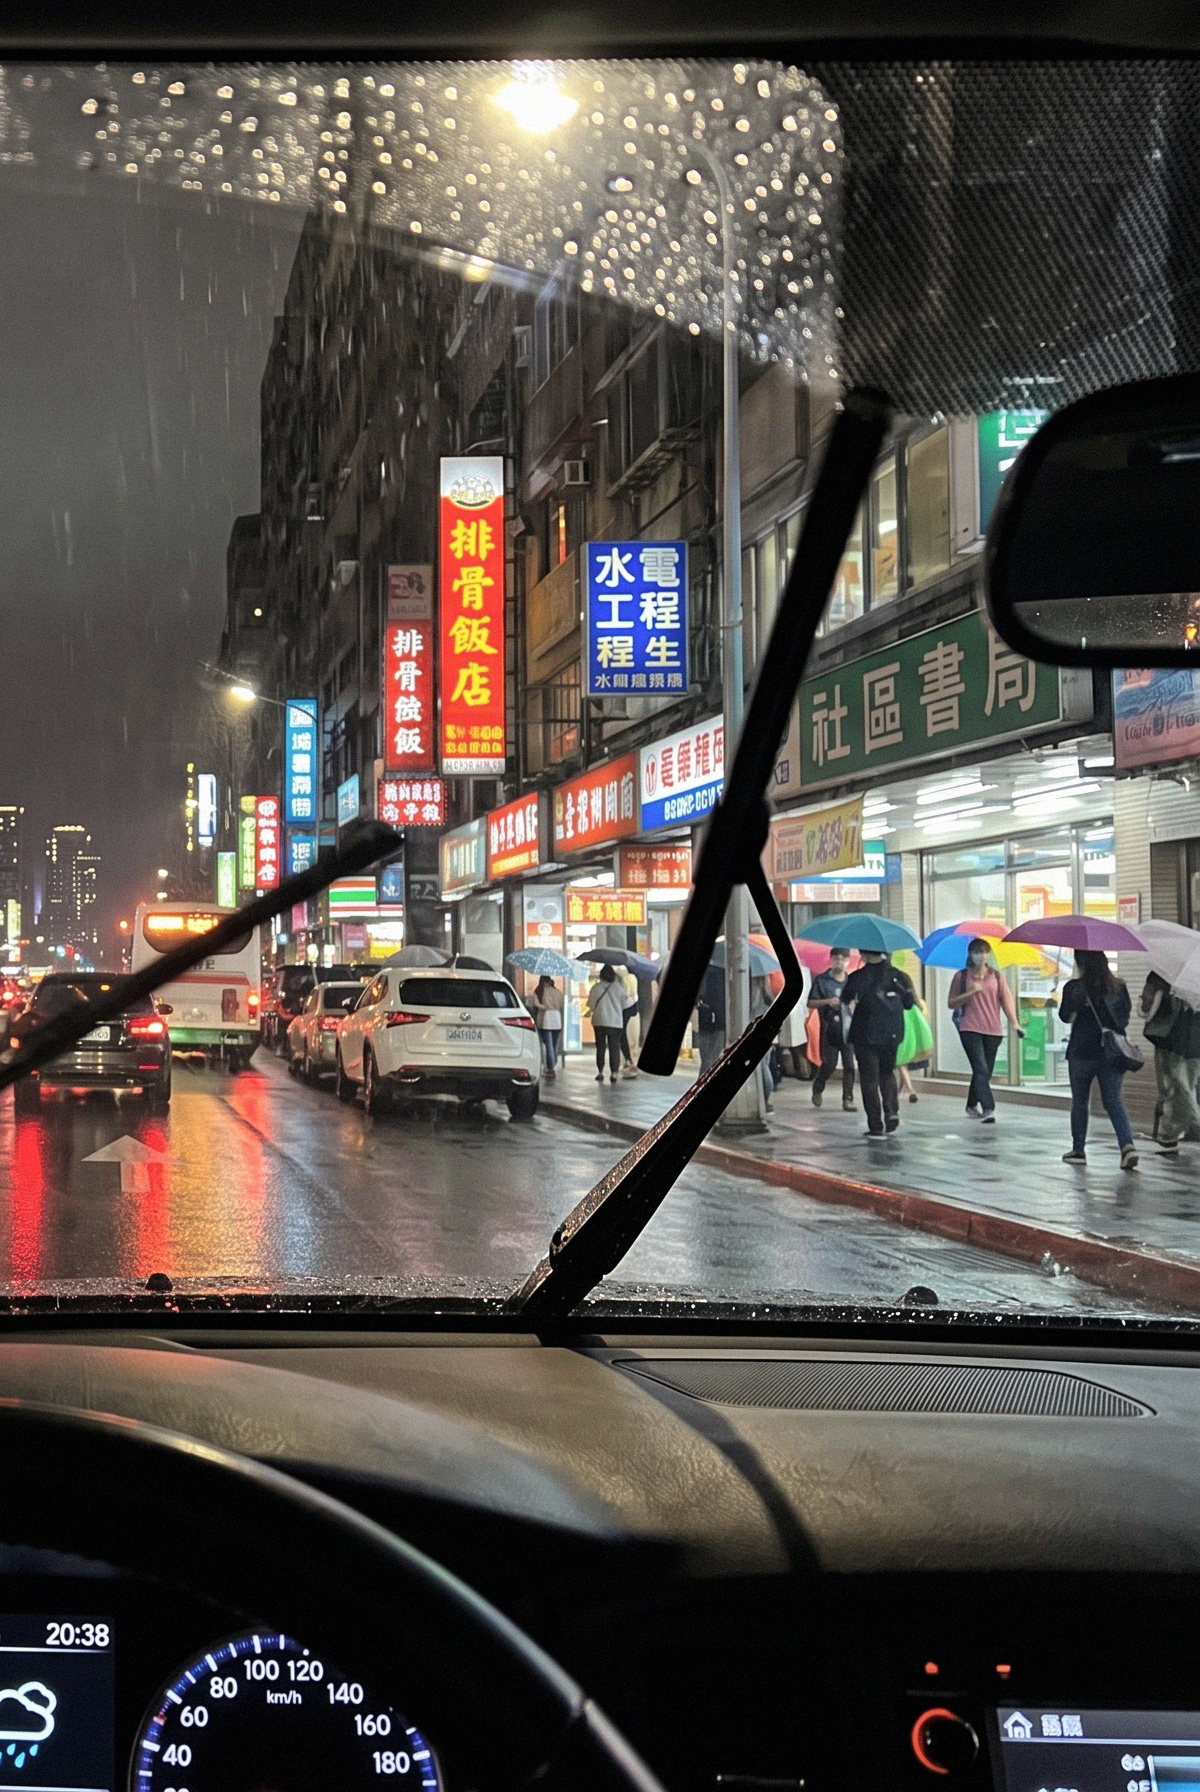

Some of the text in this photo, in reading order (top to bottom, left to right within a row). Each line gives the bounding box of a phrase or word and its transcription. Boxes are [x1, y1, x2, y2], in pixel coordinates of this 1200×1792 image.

[449, 519, 498, 706] 排骨飯店
[812, 628, 1035, 767] 社區書局
[45, 1622, 110, 1647] 20:38
[243, 1659, 280, 1681] 100
[286, 1660, 324, 1682] 120
[209, 1676, 238, 1699] 80
[266, 1689, 302, 1704] km/h
[326, 1682, 364, 1705] 140
[179, 1705, 209, 1728] 60
[354, 1713, 391, 1736] 160
[162, 1743, 192, 1767] 40
[372, 1750, 411, 1774] 180
